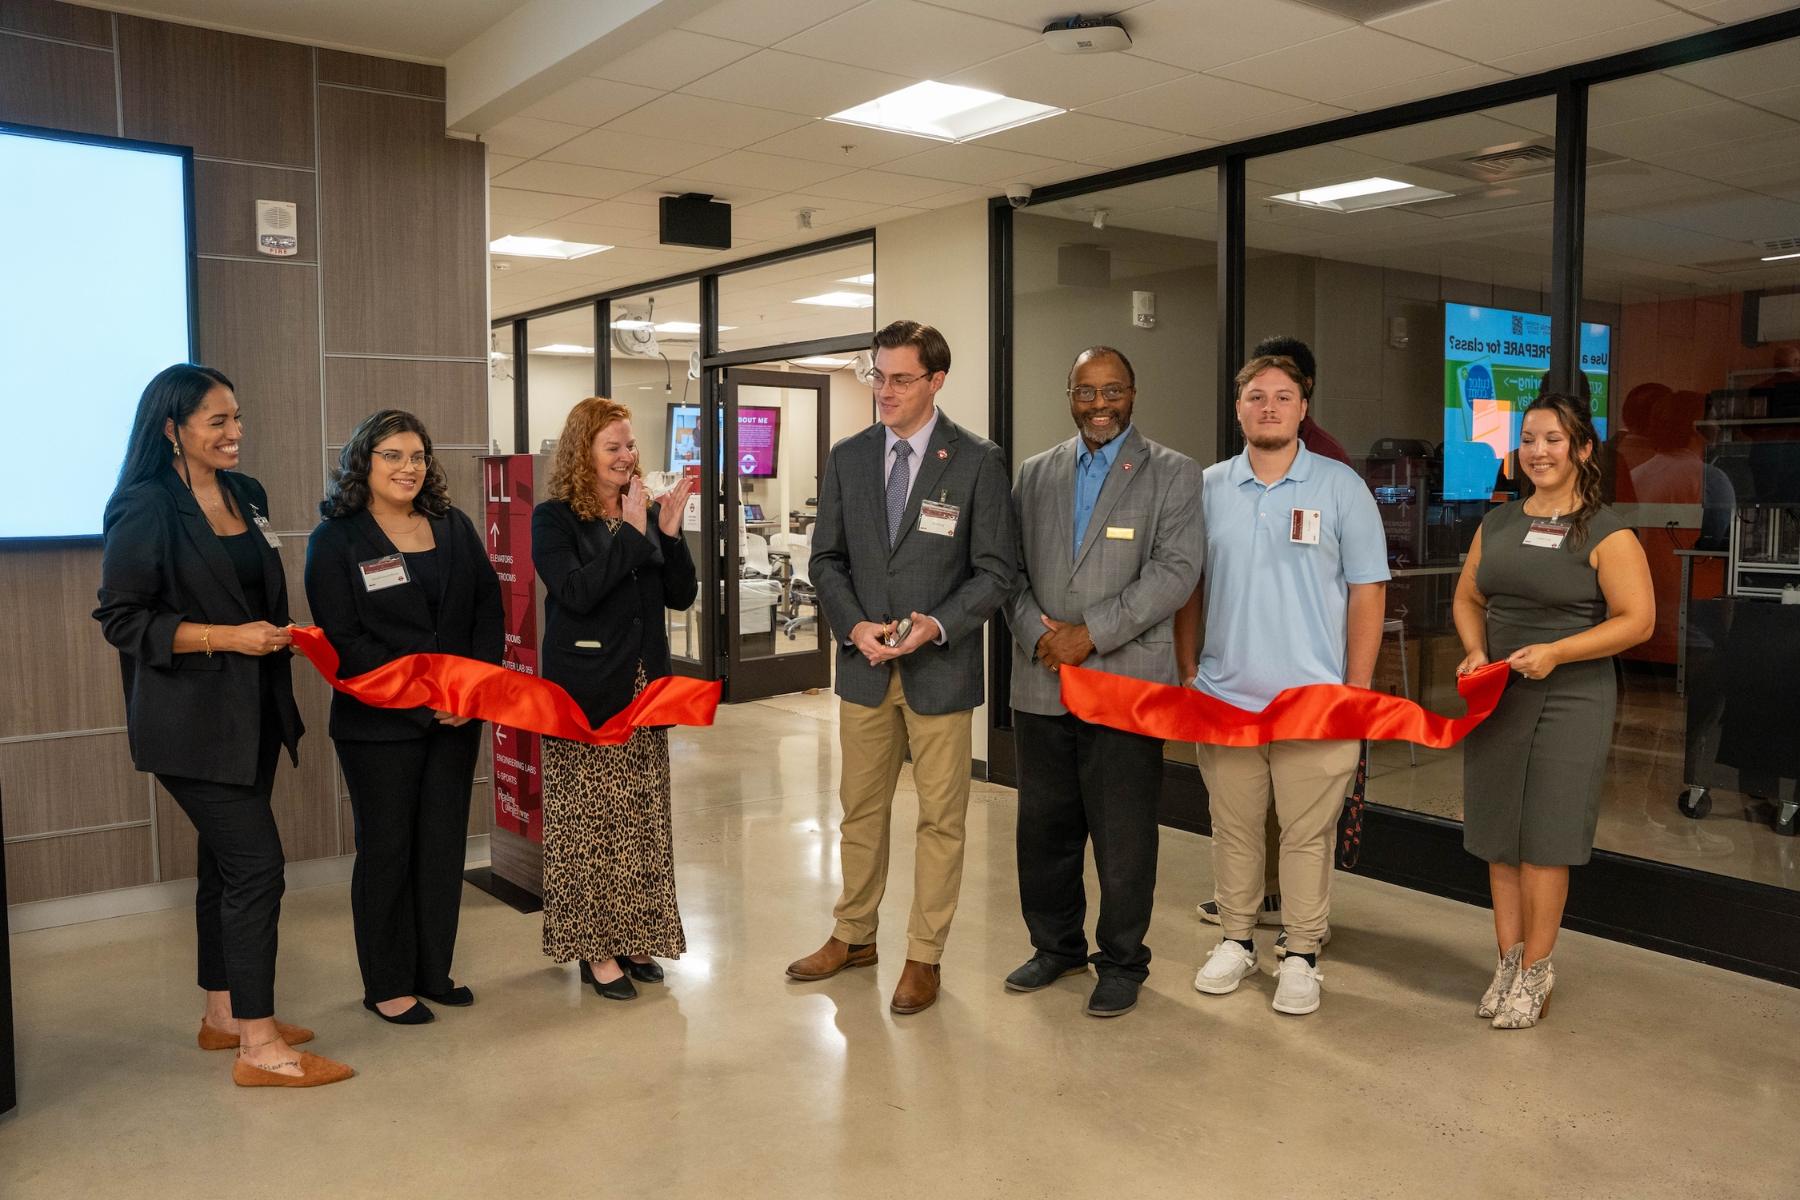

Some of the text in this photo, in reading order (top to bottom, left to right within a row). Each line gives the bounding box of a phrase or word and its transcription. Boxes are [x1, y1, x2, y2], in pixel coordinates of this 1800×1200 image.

[738, 416, 756, 424] BOUT
[489, 464, 511, 502] LL
[490, 553, 514, 564] ELEVATORS
[497, 572, 517, 583] TROOMS
[504, 633, 522, 645] ROOMS
[496, 753, 537, 775] ENGINEERING LABS
